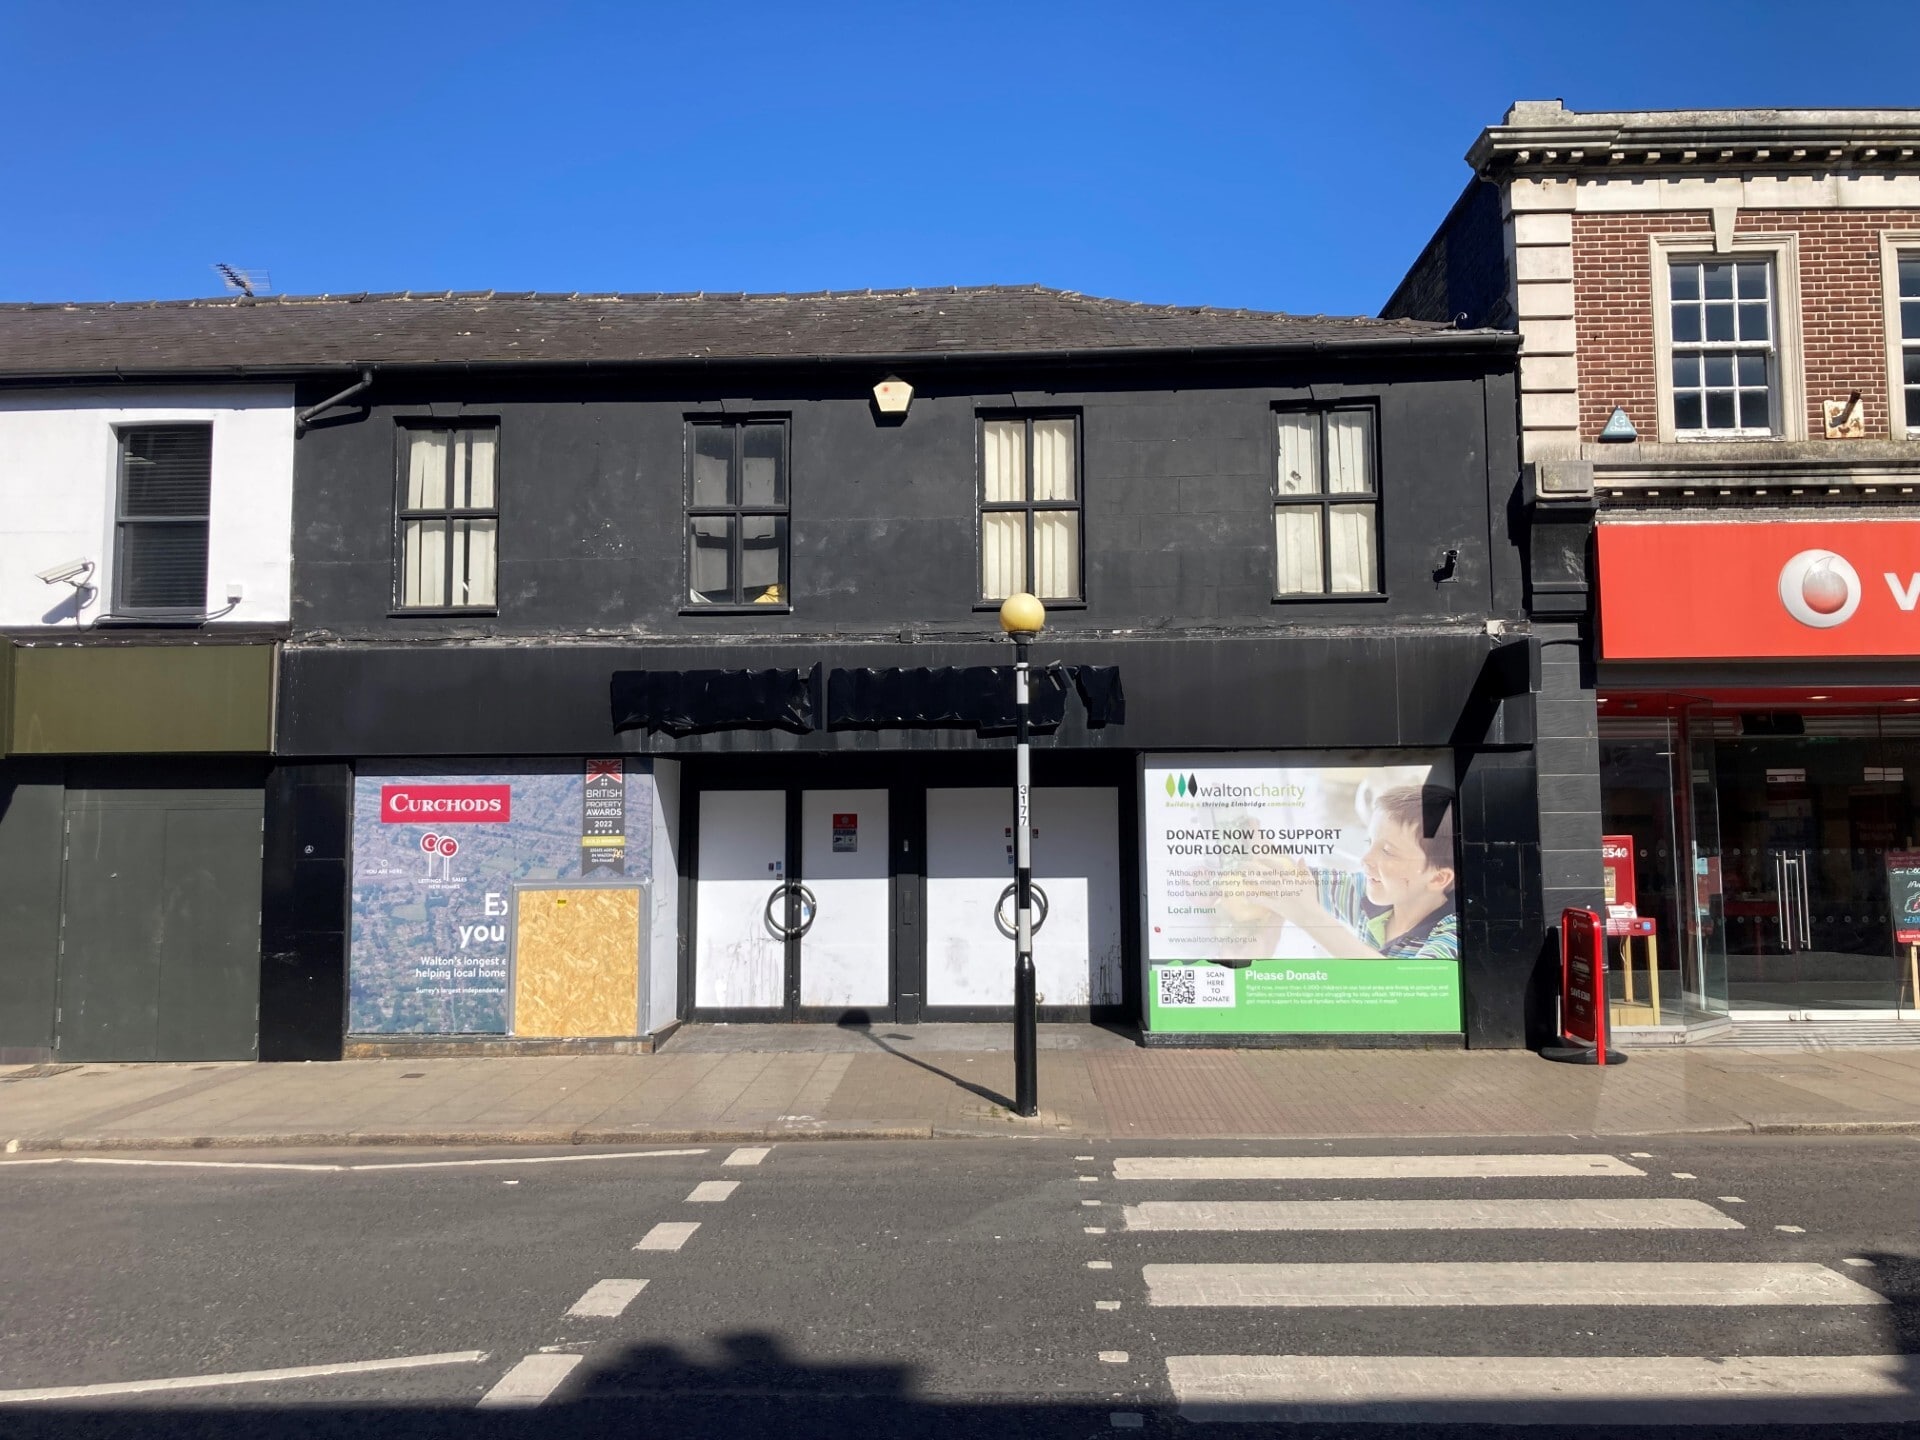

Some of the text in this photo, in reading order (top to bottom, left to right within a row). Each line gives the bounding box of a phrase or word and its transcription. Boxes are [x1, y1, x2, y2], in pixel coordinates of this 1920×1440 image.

[586, 789, 622, 798] BRITISH
[1200, 783, 1305, 800] waltoncharity
[586, 808, 622, 816] AWARDS
[594, 820, 613, 828] 2022
[1166, 829, 1342, 841] DONATE NOW TO SUPPORT
[1167, 844, 1335, 856] YOUR LOCAL COMMUNITY
[1263, 869, 1295, 877] well-paid
[1168, 906, 1191, 914] Local
[420, 956, 462, 966] Walton's
[464, 956, 499, 967] longest
[415, 968, 506, 980] helping local home
[1245, 969, 1328, 981] Please Donate
[415, 987, 439, 995] Surrey's
[441, 987, 462, 995] largest
[462, 987, 499, 995] independent
